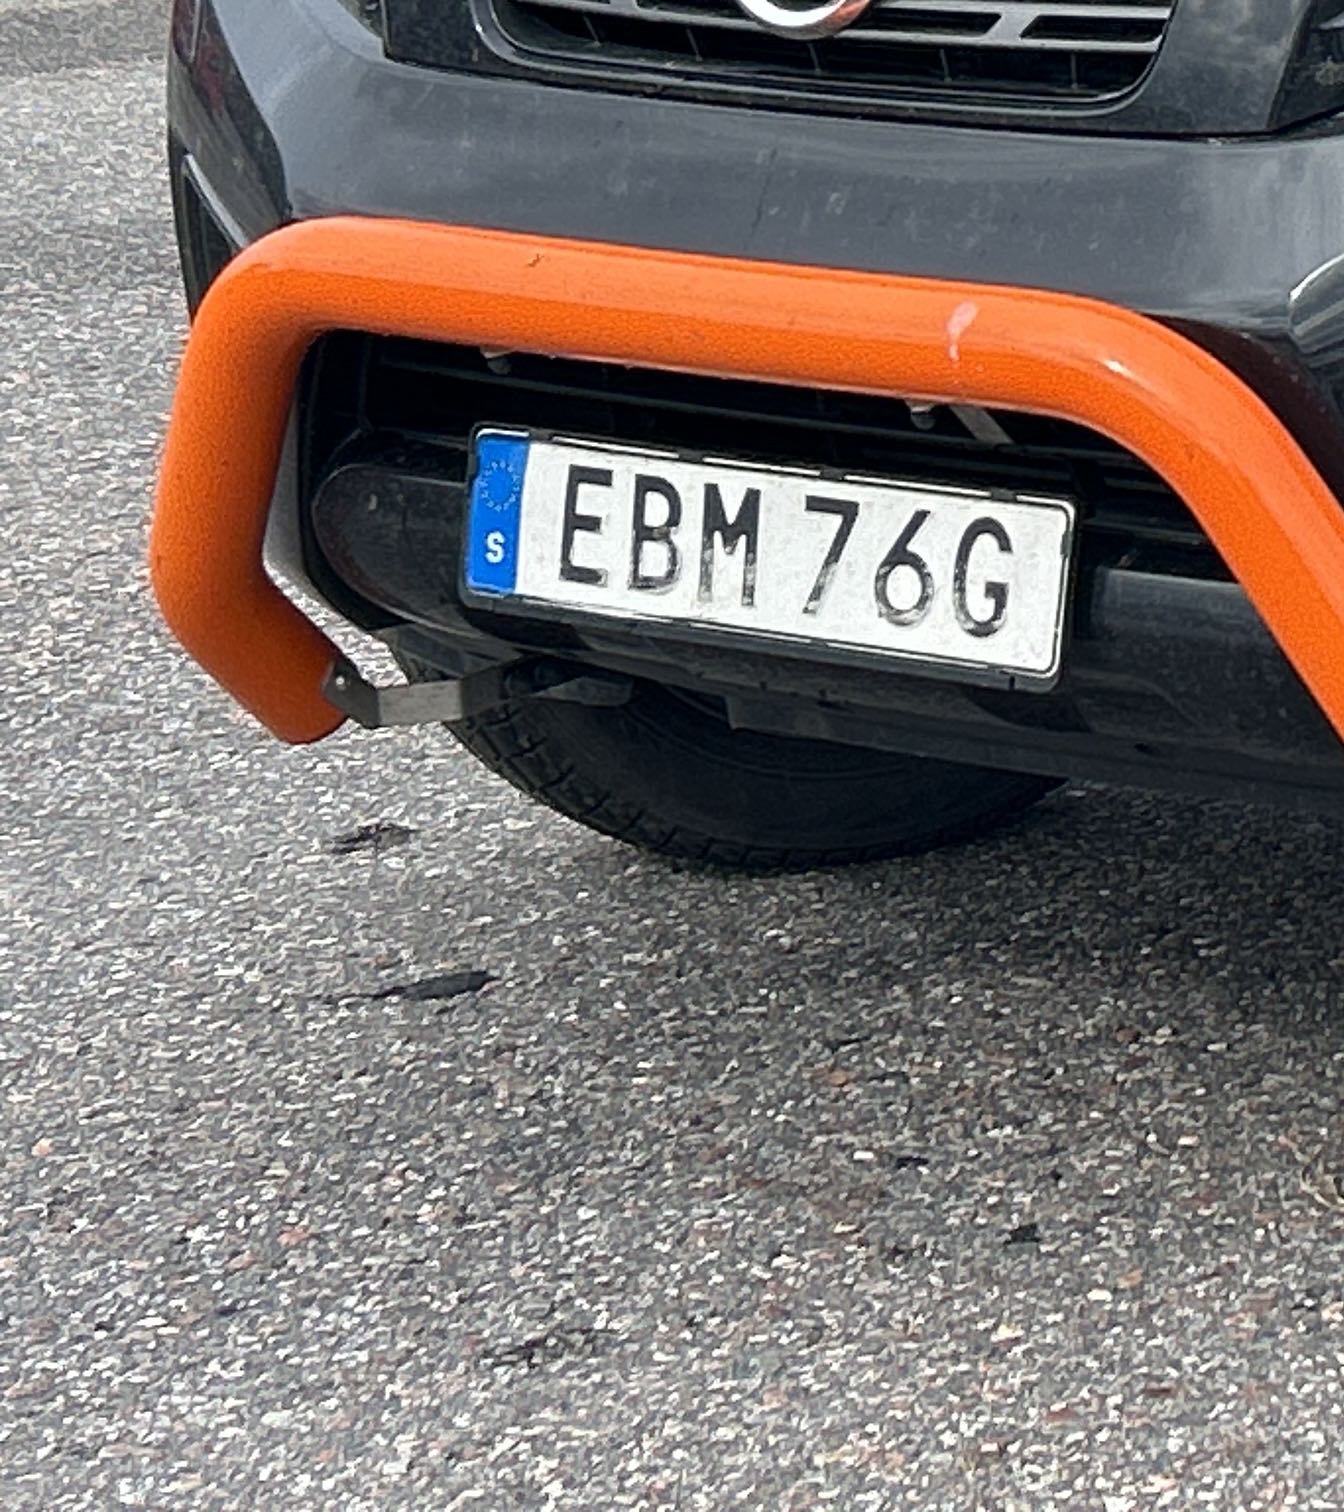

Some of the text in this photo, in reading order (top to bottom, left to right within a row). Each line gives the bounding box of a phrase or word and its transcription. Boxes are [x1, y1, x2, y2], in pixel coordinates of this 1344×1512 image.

[485, 531, 505, 563] S
[559, 463, 1014, 639] EBM 76G
